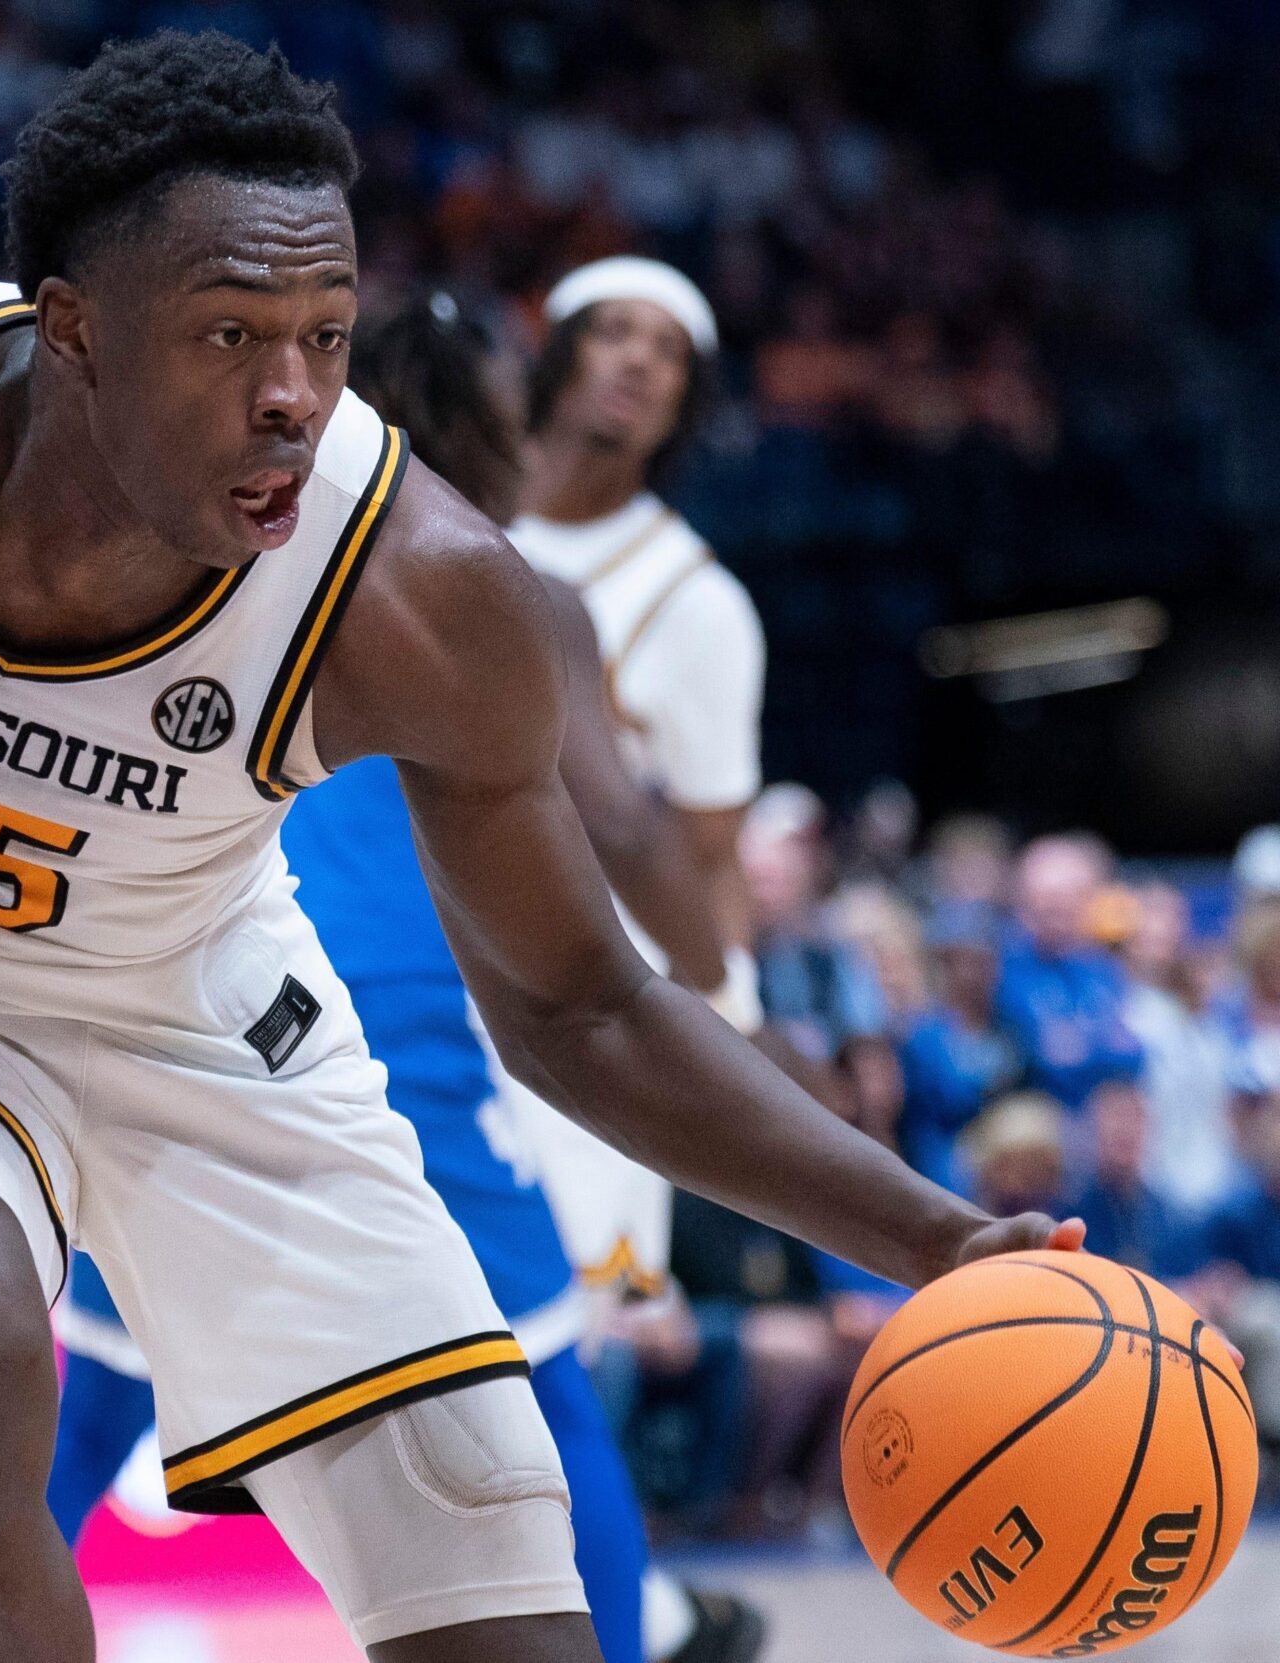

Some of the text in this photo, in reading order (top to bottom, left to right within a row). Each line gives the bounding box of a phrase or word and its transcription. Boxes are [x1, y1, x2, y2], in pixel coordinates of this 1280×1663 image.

[156, 682, 230, 750] SEC
[938, 1505, 1045, 1621] EVO
[1038, 1504, 1203, 1660] Wilso
